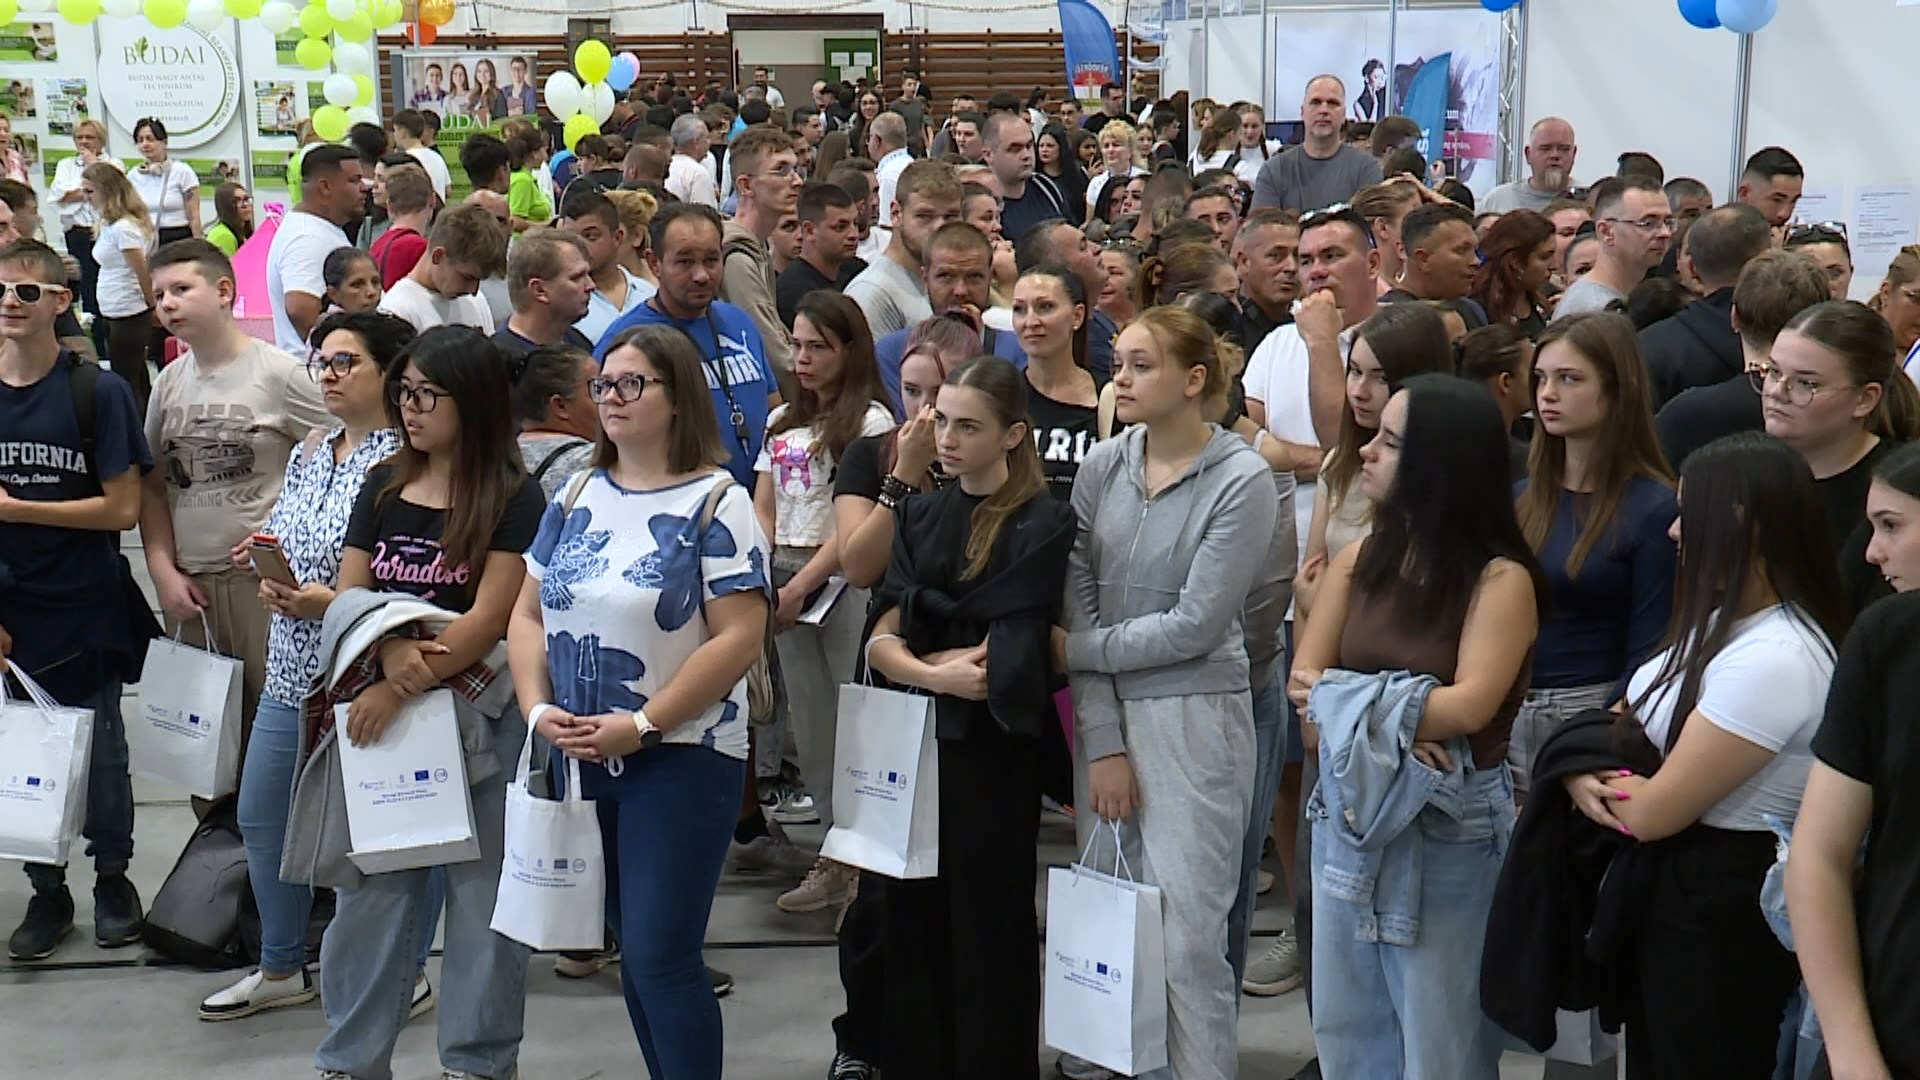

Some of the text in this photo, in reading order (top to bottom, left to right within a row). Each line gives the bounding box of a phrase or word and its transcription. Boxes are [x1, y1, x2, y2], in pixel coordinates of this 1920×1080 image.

[124, 45, 205, 65] BUDAI
[441, 113, 490, 130] UDAI
[0, 442, 88, 473] IFORNIA
